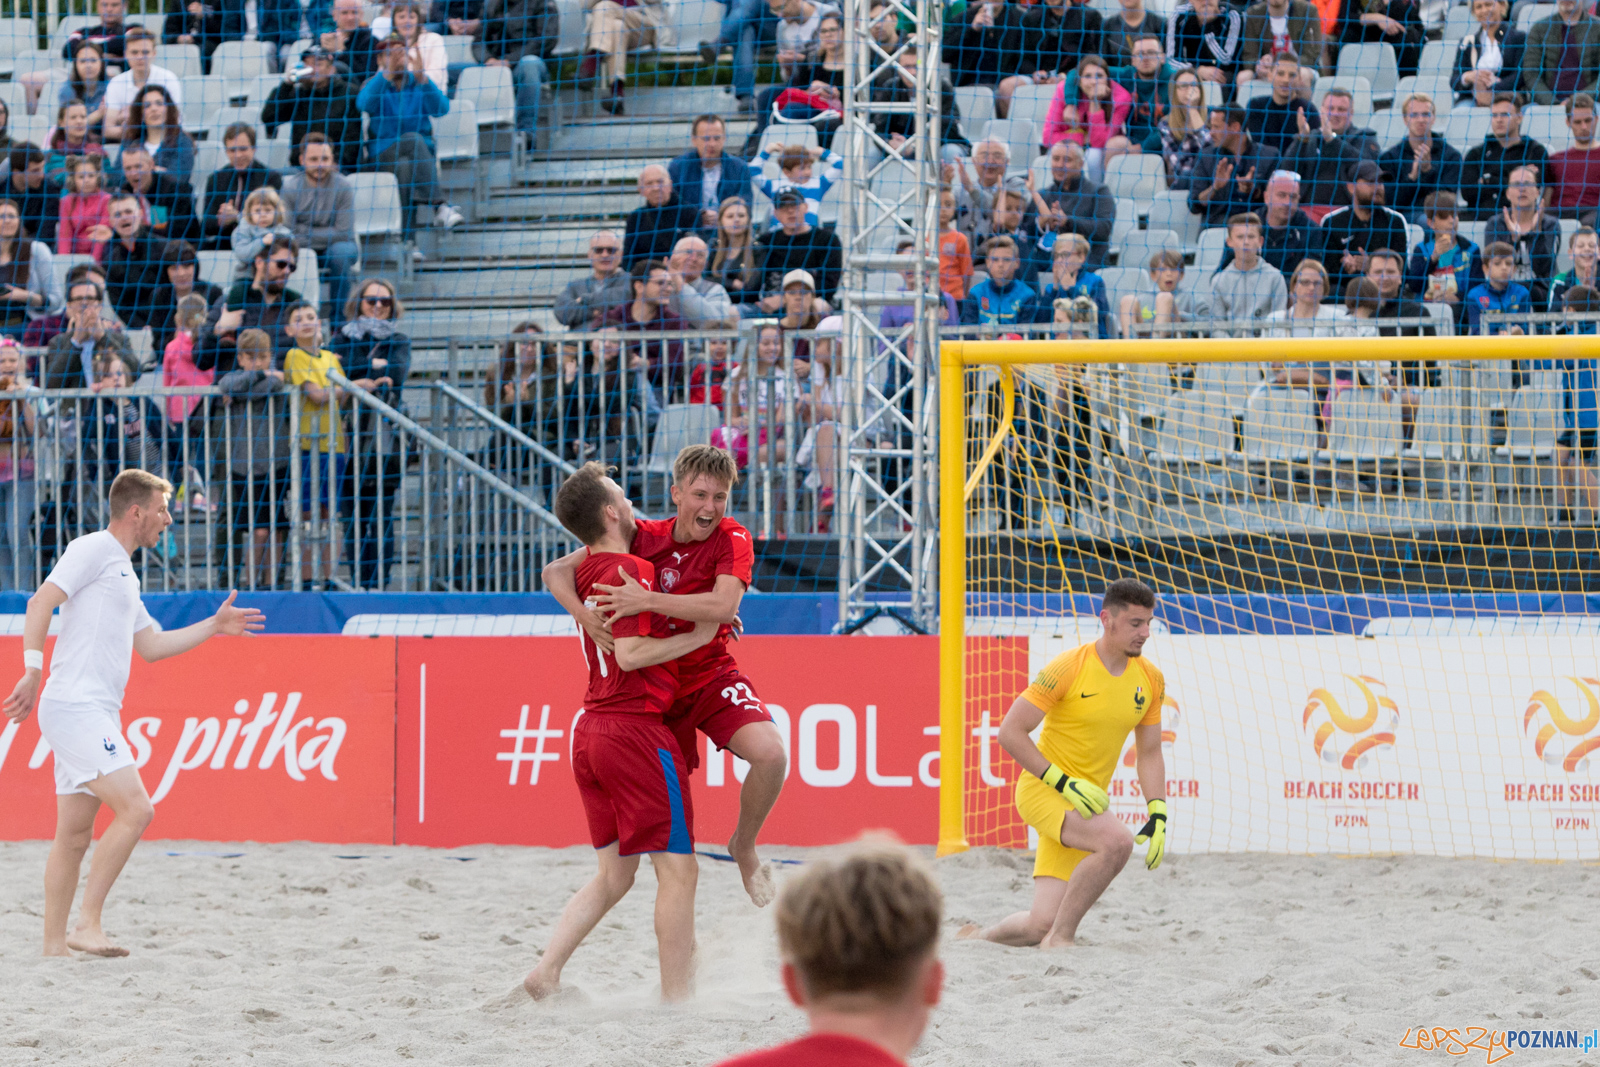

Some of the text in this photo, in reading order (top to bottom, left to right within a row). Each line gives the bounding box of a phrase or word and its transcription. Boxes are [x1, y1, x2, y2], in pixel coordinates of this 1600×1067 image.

[721, 682, 761, 706] 22
[150, 692, 347, 805] piłka
[1130, 779, 1199, 798] SCER
[1284, 781, 1418, 800] BEACH SOCCER
[1504, 783, 1564, 802] BEACH
[1335, 815, 1368, 827] PZPN
[1556, 817, 1590, 830] PZPN
